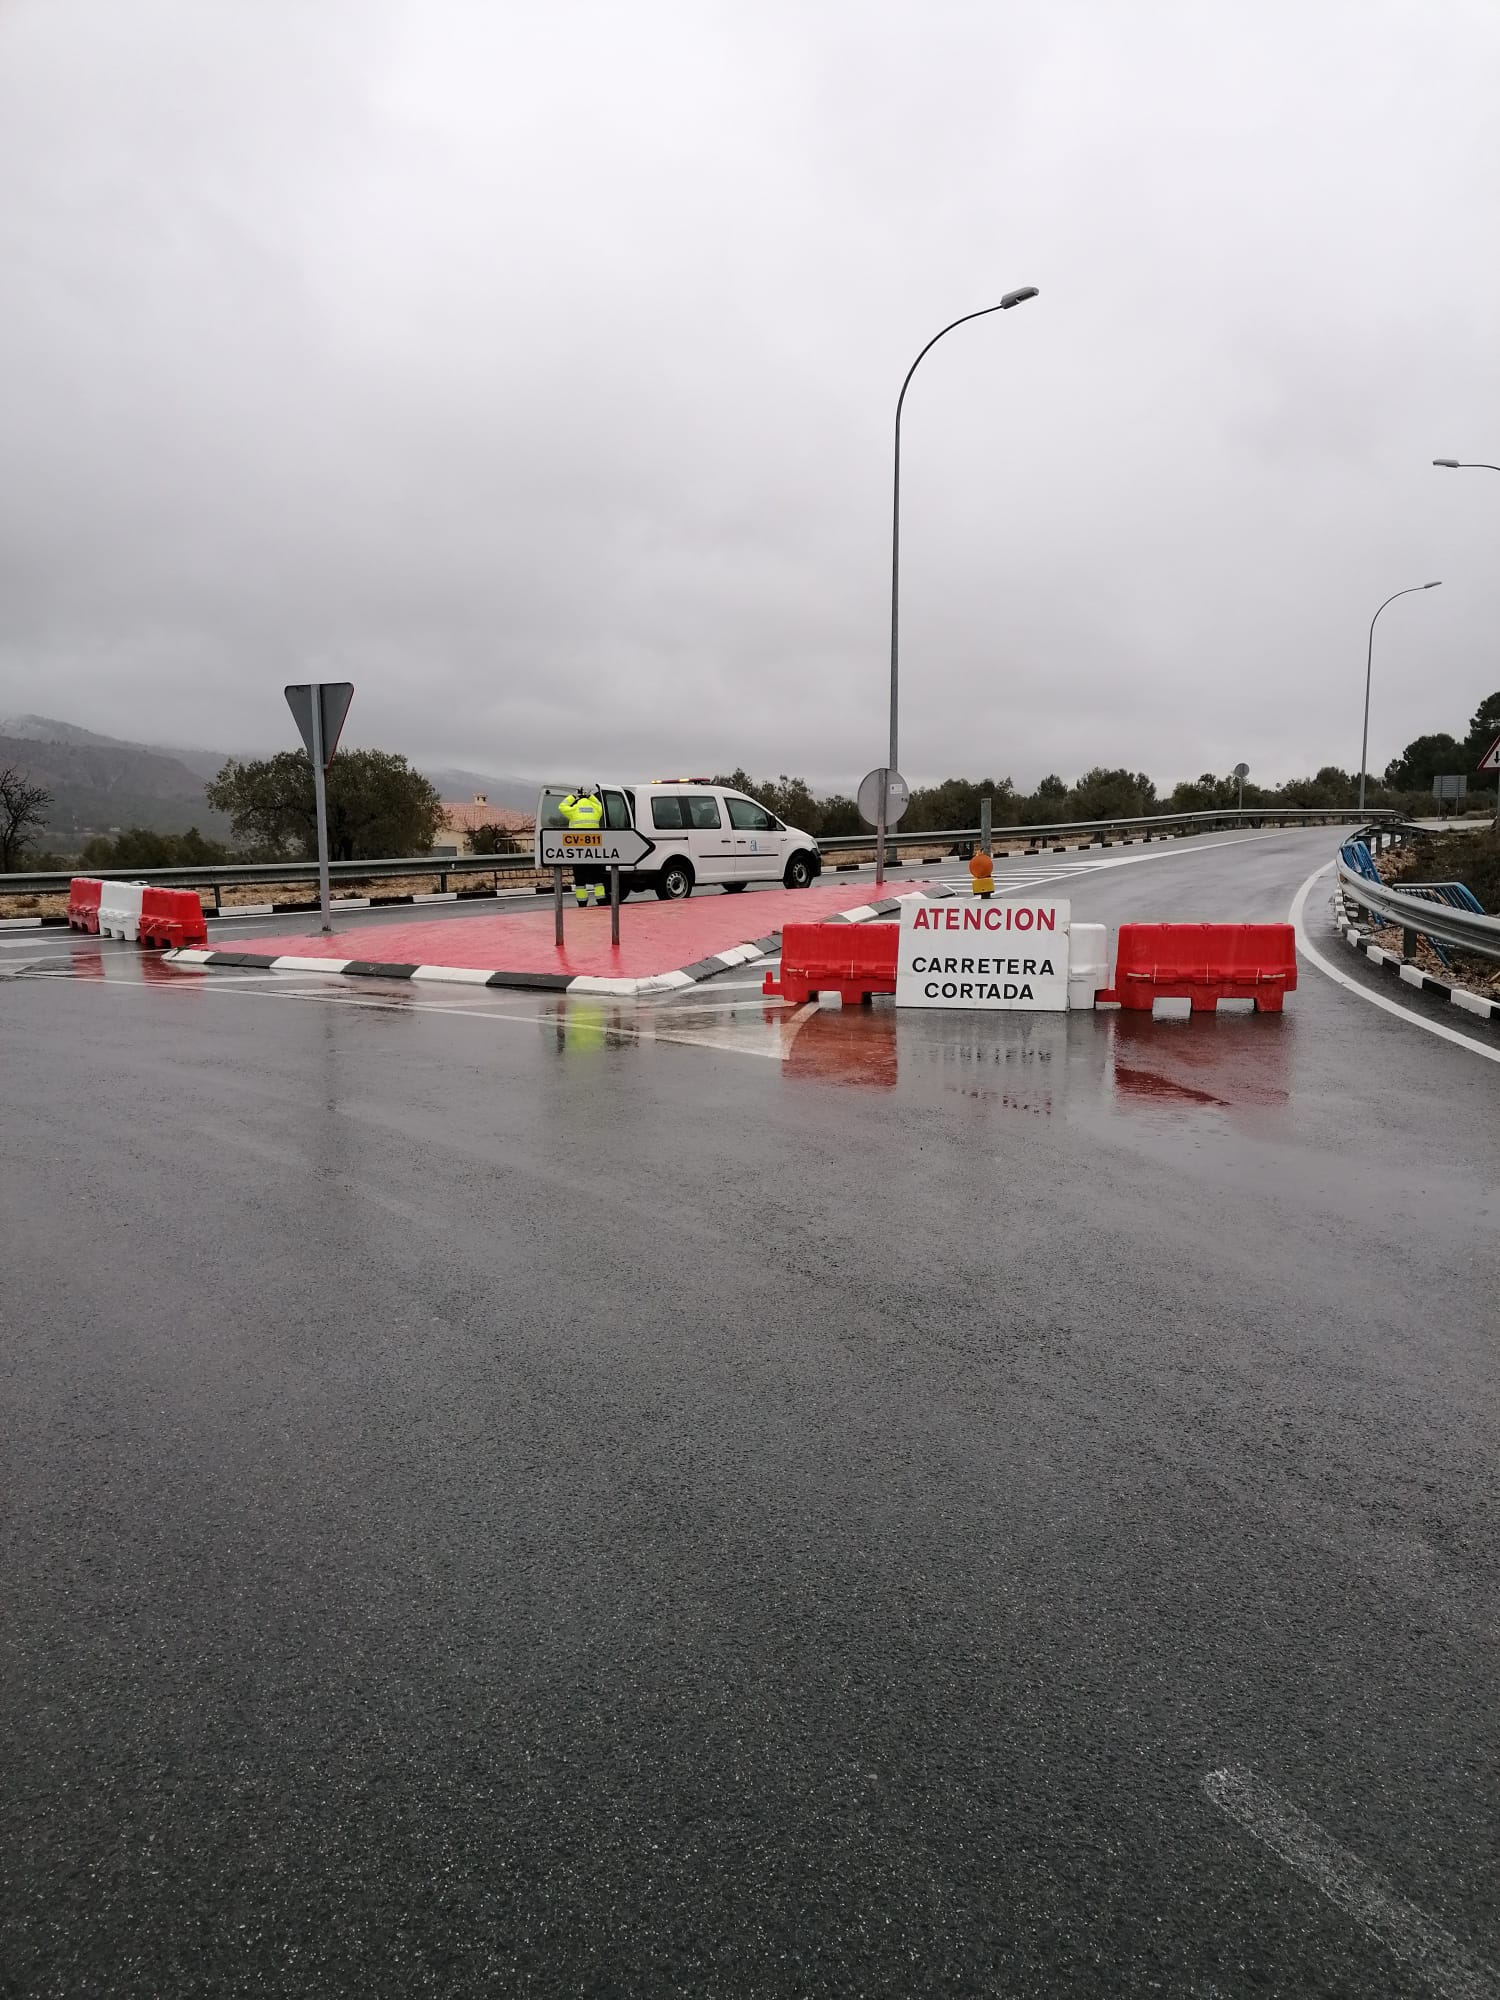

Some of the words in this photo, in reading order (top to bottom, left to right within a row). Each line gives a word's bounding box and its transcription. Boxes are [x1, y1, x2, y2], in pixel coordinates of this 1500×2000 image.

[564, 835, 601, 844] CV-811
[545, 848, 620, 859] CASTALLA
[913, 907, 1056, 931] ATENCION
[912, 957, 1055, 976] CARRETERA
[924, 982, 1034, 1000] CORTADA
